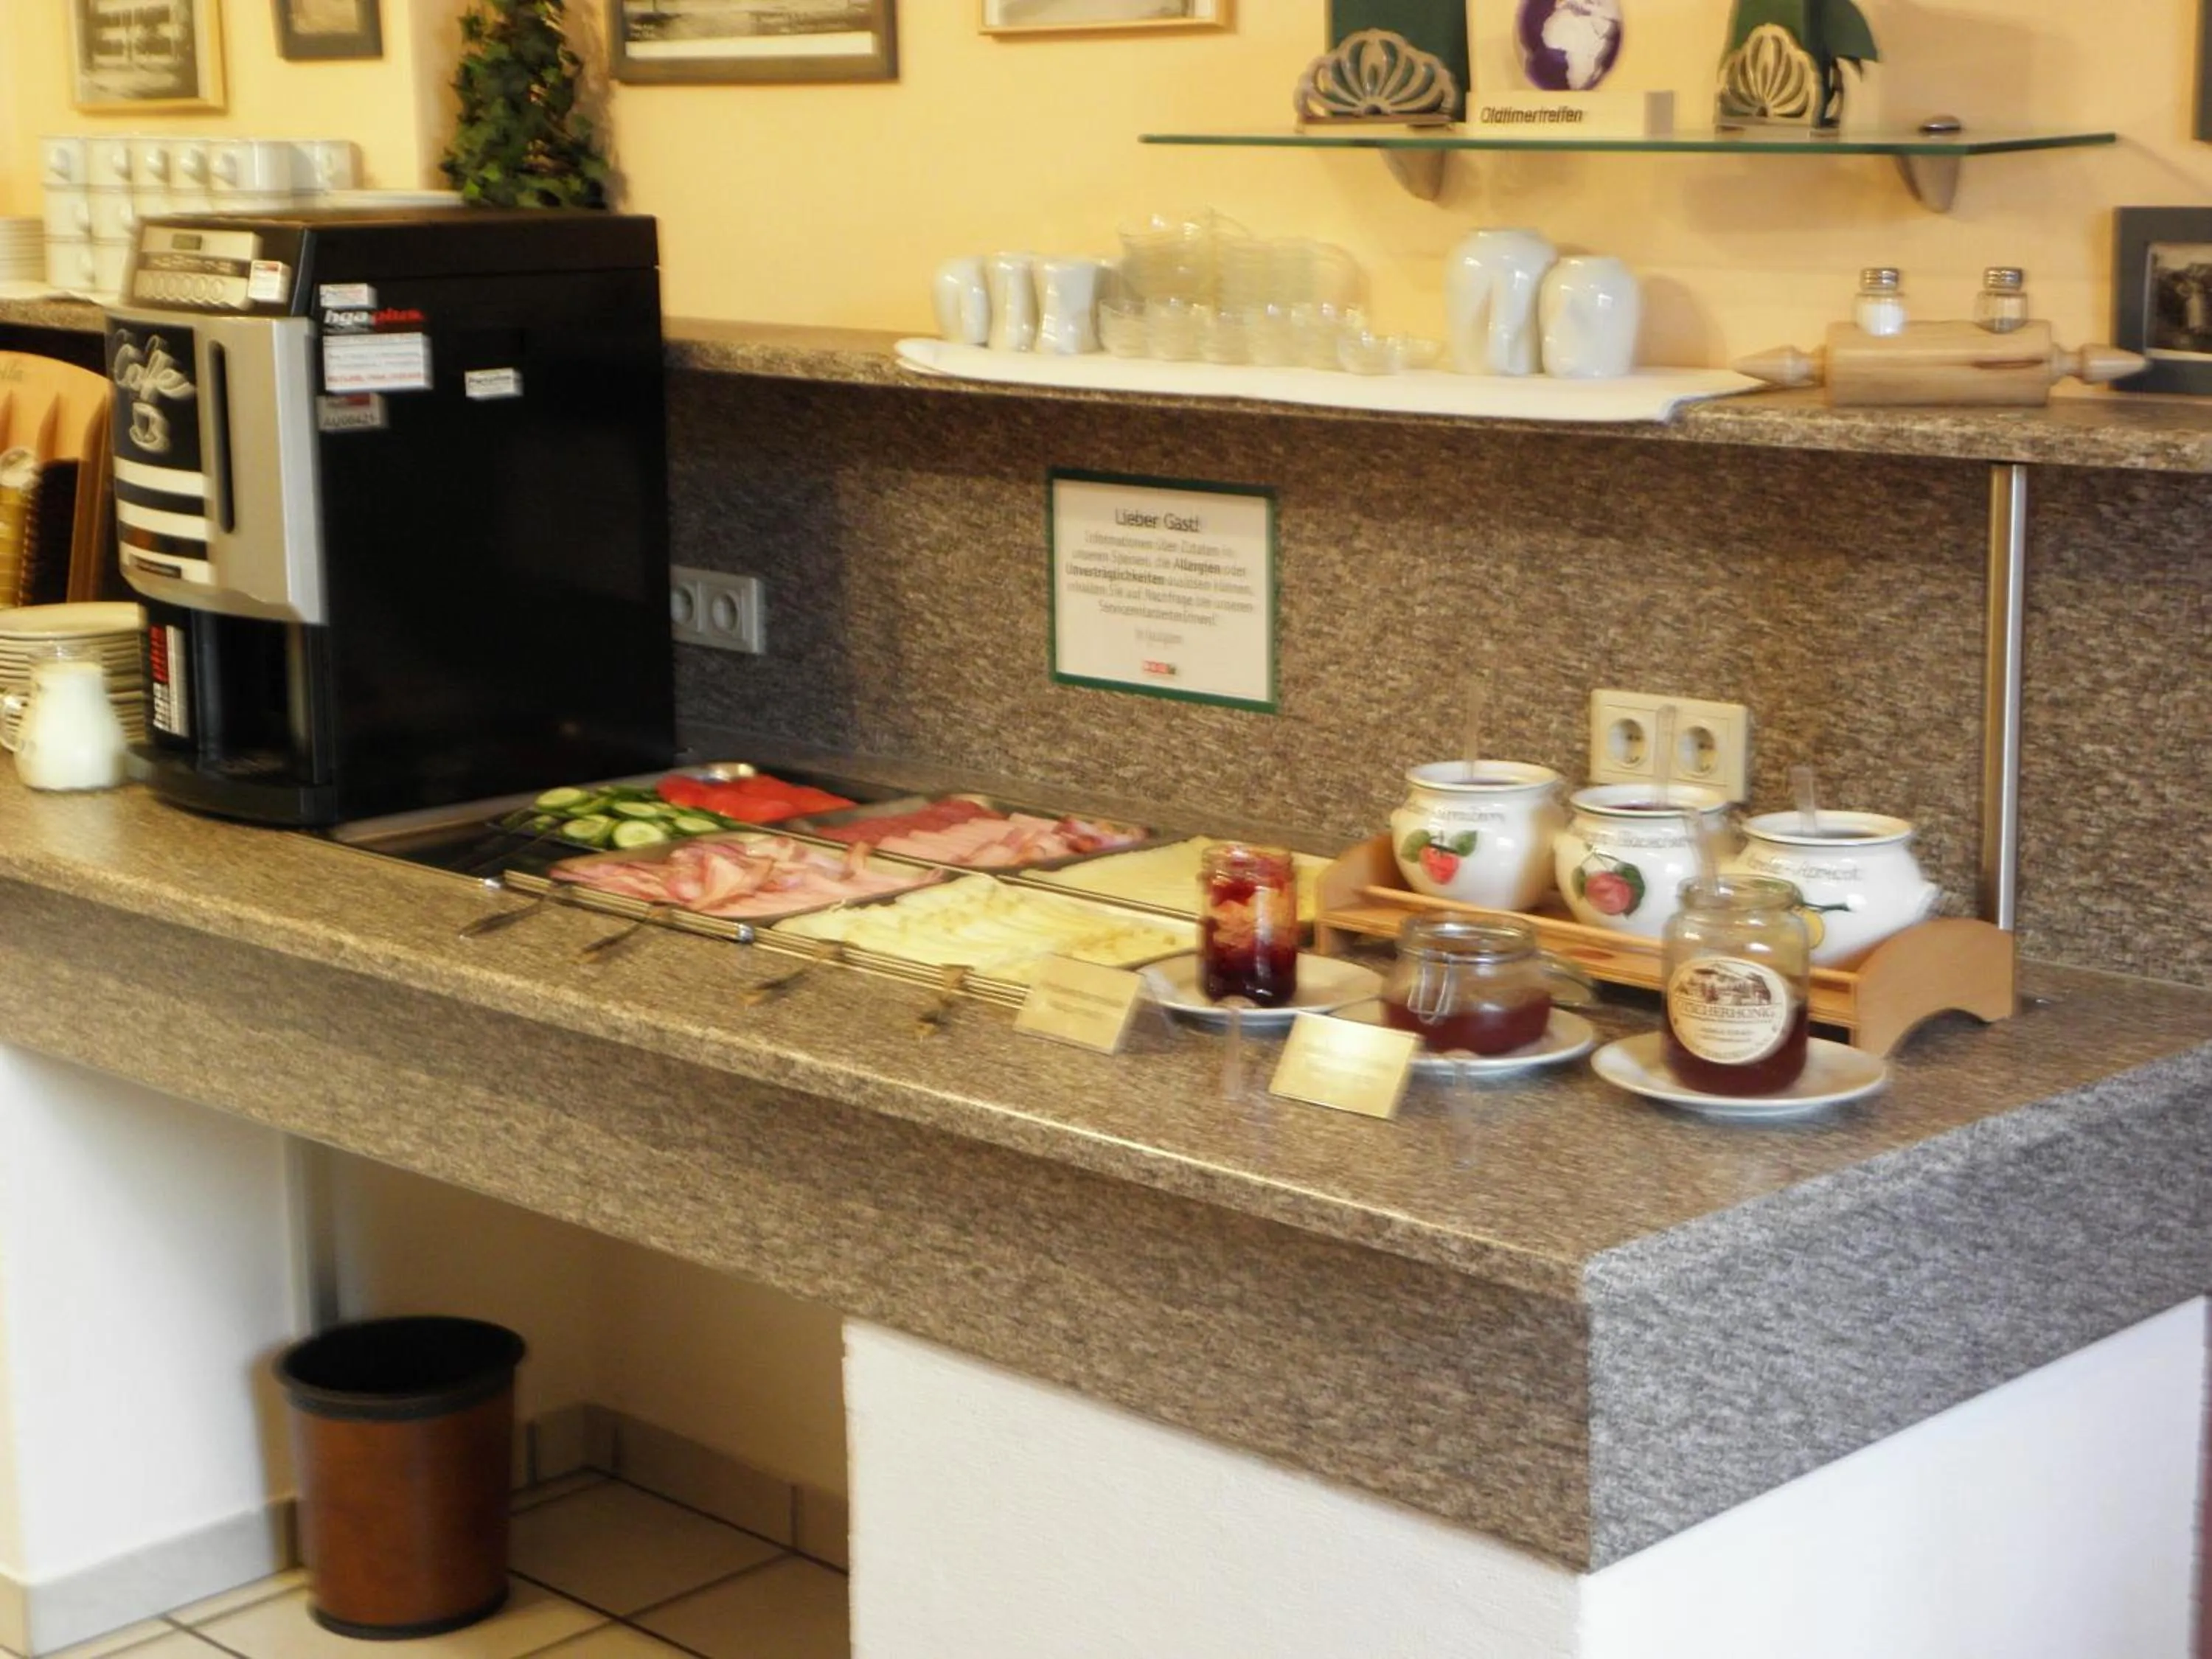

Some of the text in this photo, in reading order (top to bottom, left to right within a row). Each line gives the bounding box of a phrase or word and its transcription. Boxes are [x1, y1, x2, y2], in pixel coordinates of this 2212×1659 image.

[1481, 106, 1584, 124] Oldtimertreffen
[1114, 507, 1200, 532] Lieber Gast!
[1173, 559, 1220, 577] Allergien
